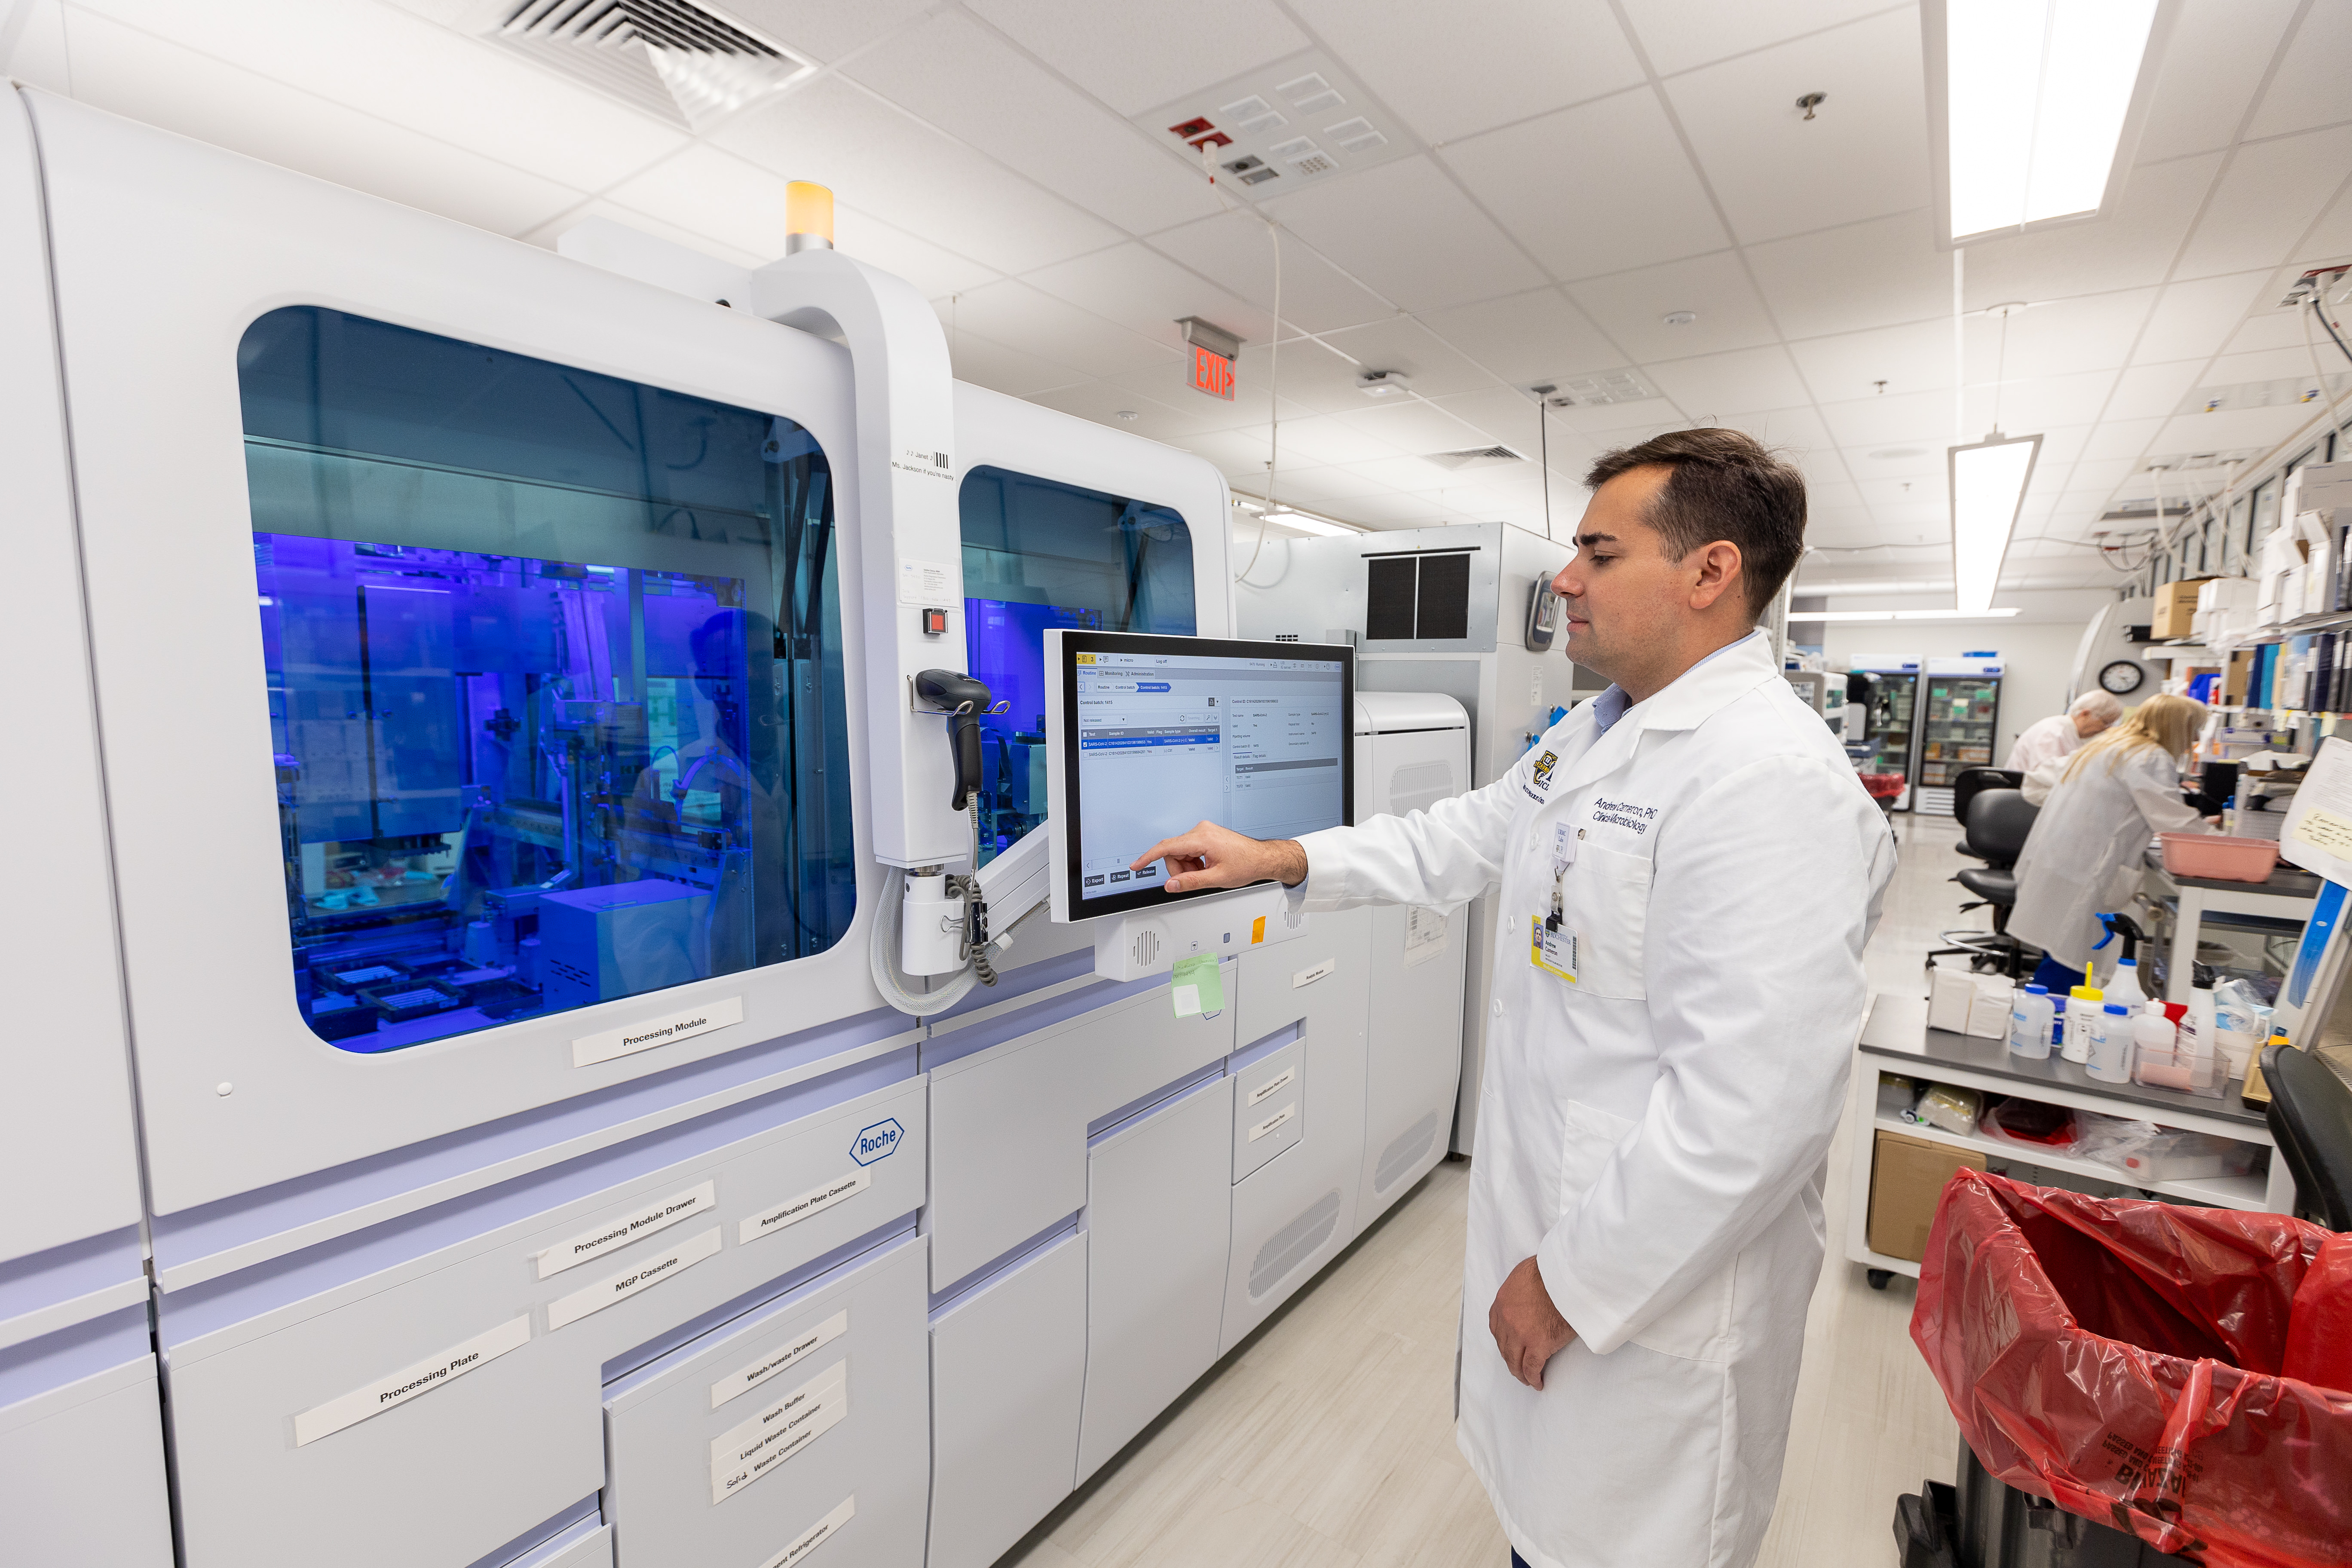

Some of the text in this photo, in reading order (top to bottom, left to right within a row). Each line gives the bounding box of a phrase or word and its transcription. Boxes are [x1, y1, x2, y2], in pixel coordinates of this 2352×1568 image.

[1196, 347, 1228, 395] EXIT
[903, 464, 922, 473] Jackson
[1594, 798, 1617, 811] Andrew
[1643, 808, 1658, 819] PhD
[1610, 813, 1648, 835] Microbiology
[1545, 940, 1556, 949] Andrew
[1545, 946, 1558, 956] Cameron
[1550, 931, 1571, 945] ROCHESTER
[623, 1017, 707, 1047] Processing Module
[1256, 1085, 1274, 1098] Amplification
[1262, 1118, 1279, 1130] Amplification
[860, 1128, 896, 1156] Roche
[761, 1179, 857, 1228] Amplification Plate Cassette
[574, 1197, 697, 1254] Processing Module Drawer
[615, 1258, 678, 1292] MGP Cassette
[747, 1336, 818, 1382] Wash/waste Drawer
[380, 1351, 479, 1403] Processing Plate
[762, 1392, 806, 1424] Wash Buffer
[740, 1403, 821, 1461] Liquid Waste Container
[726, 1429, 812, 1489] Solid Waste Container
[789, 1525, 829, 1559] Refrigerator
